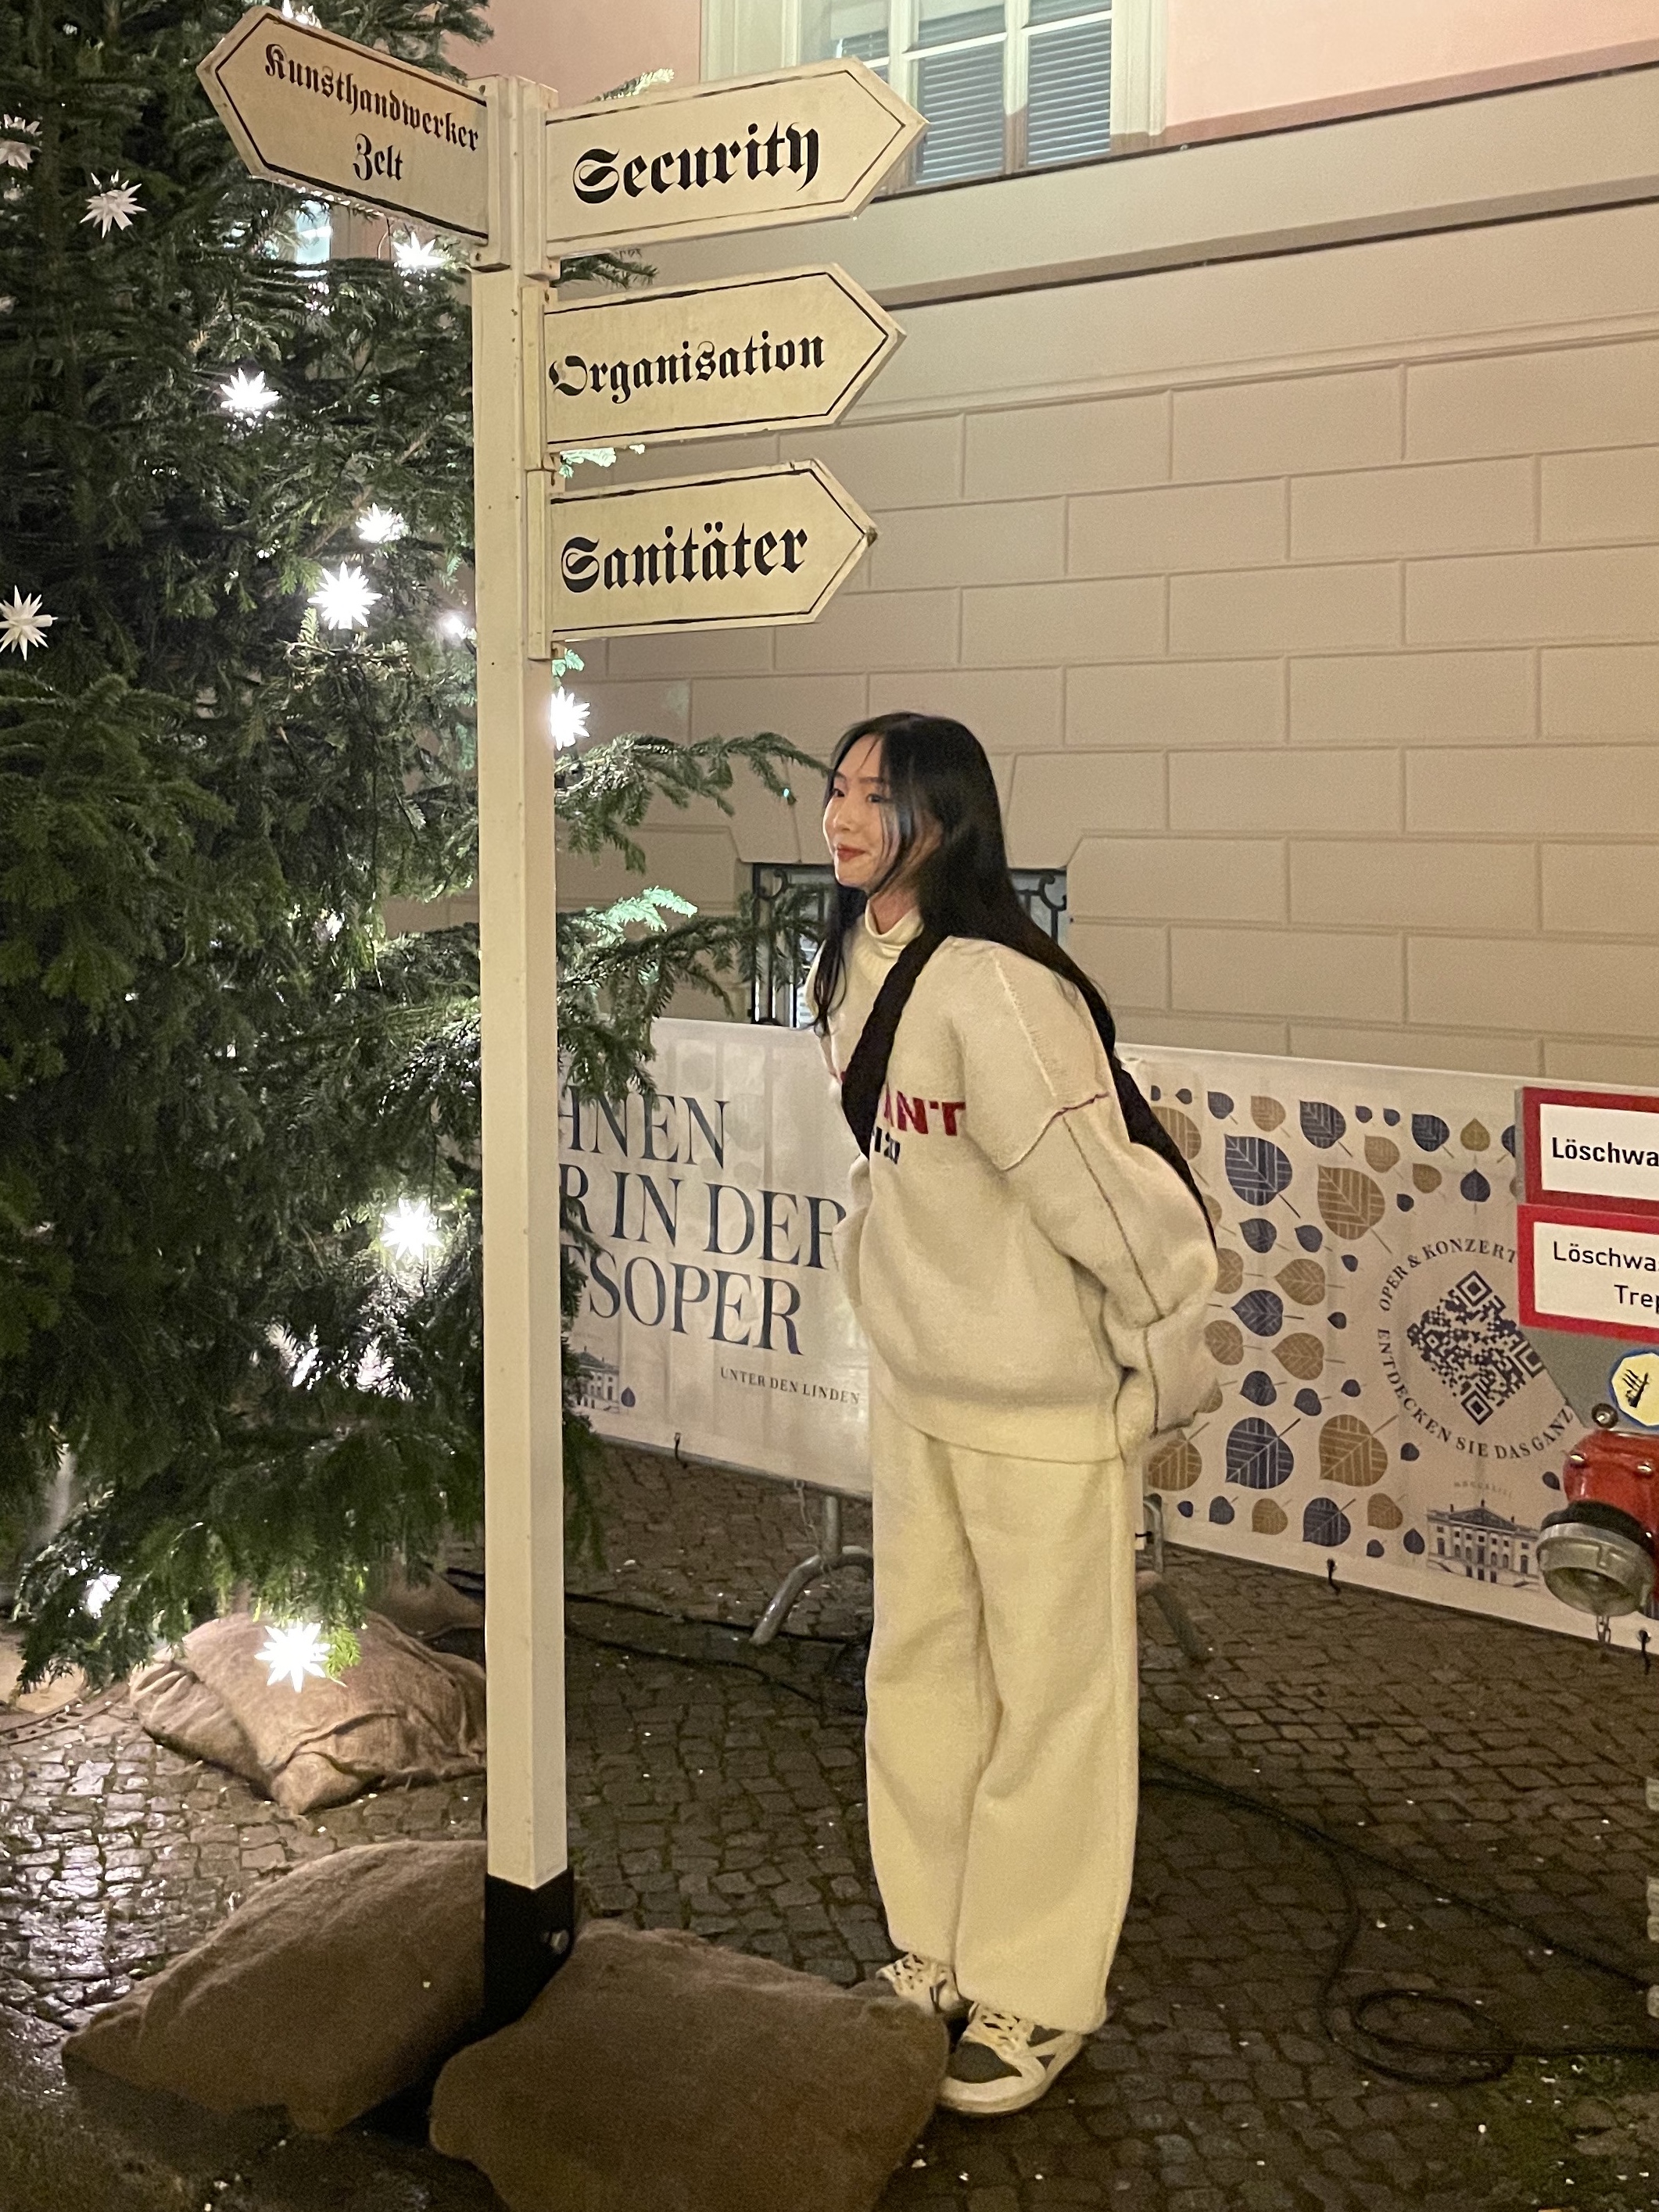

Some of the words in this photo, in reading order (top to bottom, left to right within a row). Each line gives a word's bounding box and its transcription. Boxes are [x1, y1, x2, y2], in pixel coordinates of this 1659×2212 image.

[264, 43, 478, 151] Kunsthandwerker
[353, 133, 403, 181] Zelt
[572, 121, 819, 204] Security
[549, 330, 825, 404] Organisation
[561, 521, 808, 593] Sanitäter
[1552, 1136, 1659, 1167] Löschwa
[611, 1170, 684, 1247] IN
[1379, 1265, 1408, 1312] OPER
[1407, 1255, 1421, 1268] &
[1553, 1240, 1659, 1272] Löschwa
[720, 1367, 765, 1387] UNTER
[770, 1376, 797, 1394] DEN
[802, 1383, 860, 1405] LINDEN
[1378, 1329, 1453, 1443] ENTDECKEN
[1456, 1436, 1489, 1458] SIE
[1494, 1442, 1531, 1459] DAS
